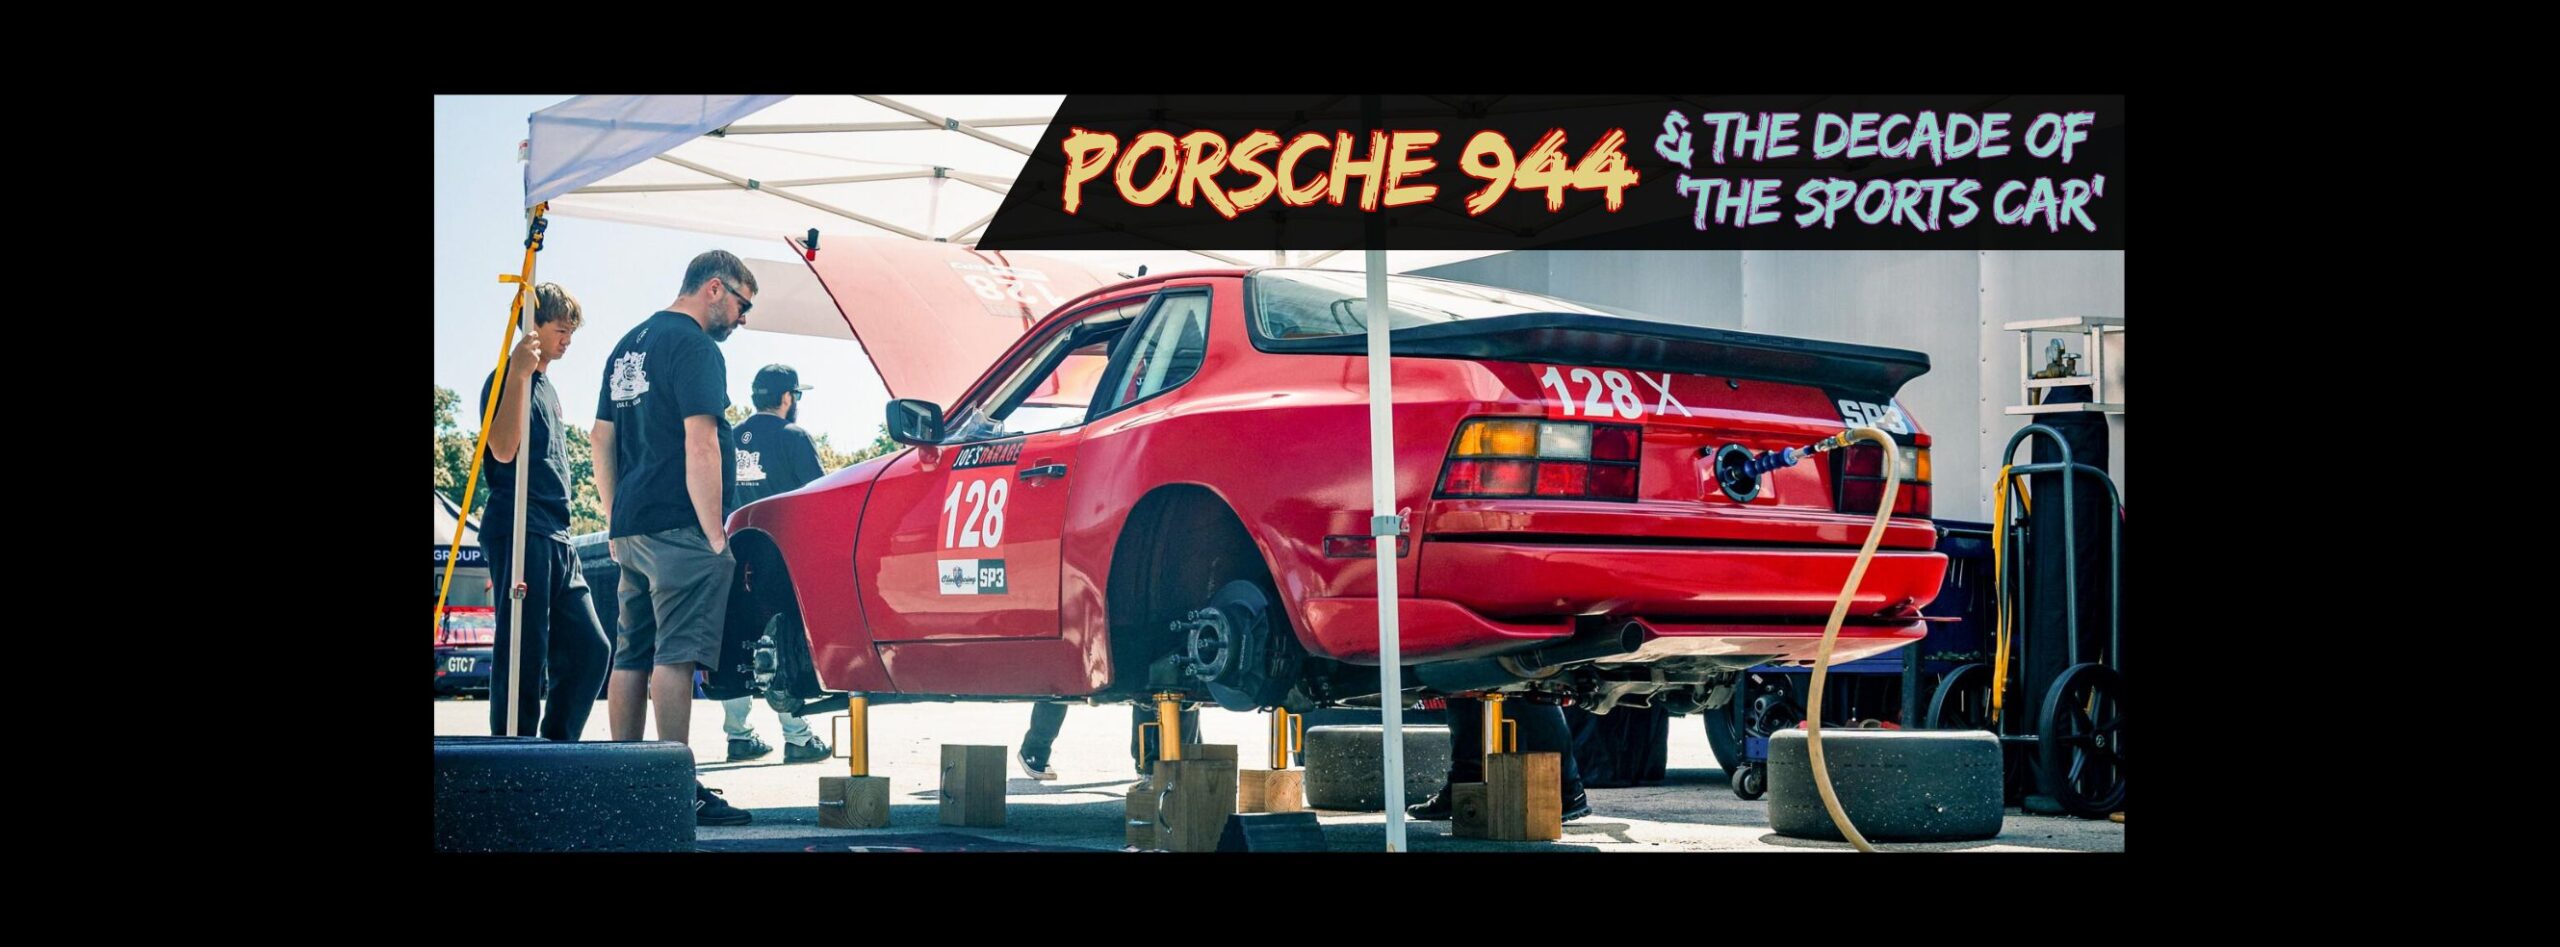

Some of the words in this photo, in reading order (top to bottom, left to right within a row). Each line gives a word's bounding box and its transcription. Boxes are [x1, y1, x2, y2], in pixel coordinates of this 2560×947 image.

[1541, 366, 1643, 420] 128
[1636, 371, 1693, 417] X
[953, 445, 983, 468] JOE'S
[943, 477, 1009, 549] 128
[980, 568, 1005, 588] SP3
